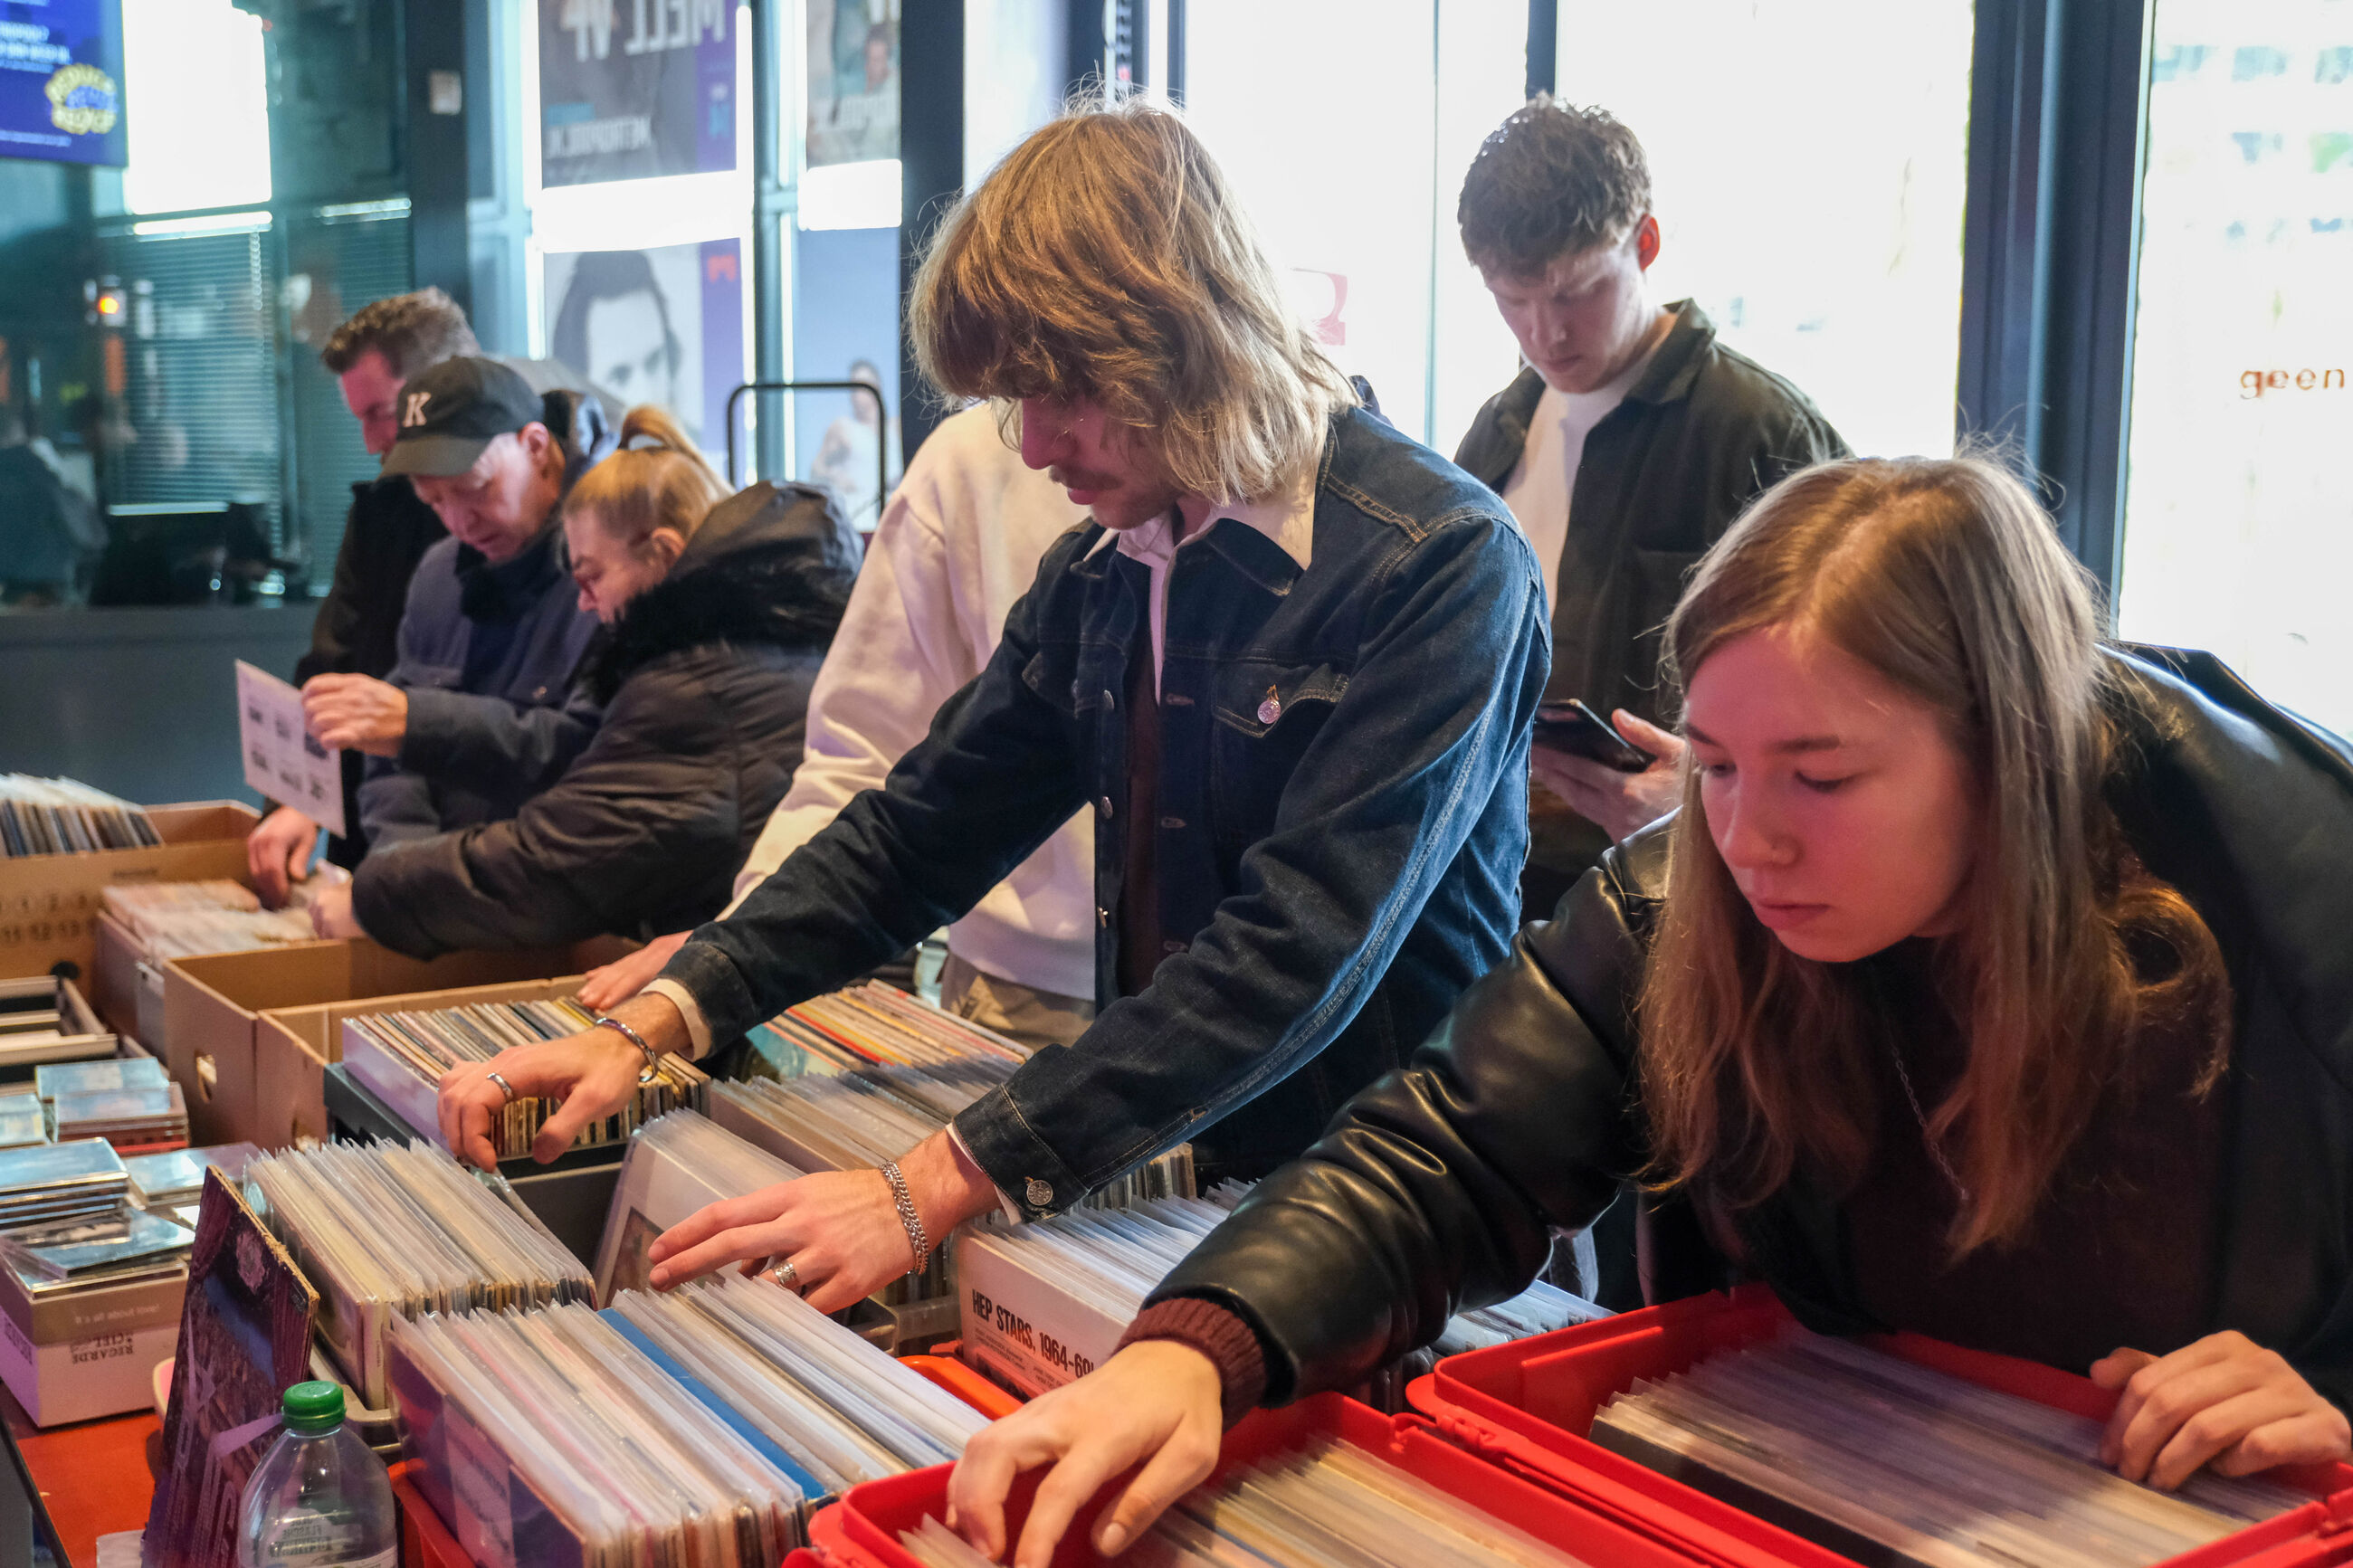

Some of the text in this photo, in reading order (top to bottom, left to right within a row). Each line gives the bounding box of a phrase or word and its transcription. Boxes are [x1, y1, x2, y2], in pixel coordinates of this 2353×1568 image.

[2240, 367, 2345, 400] geen
[403, 392, 432, 427] K
[972, 1288, 993, 1323] HEP
[996, 1304, 1037, 1354] STARS,
